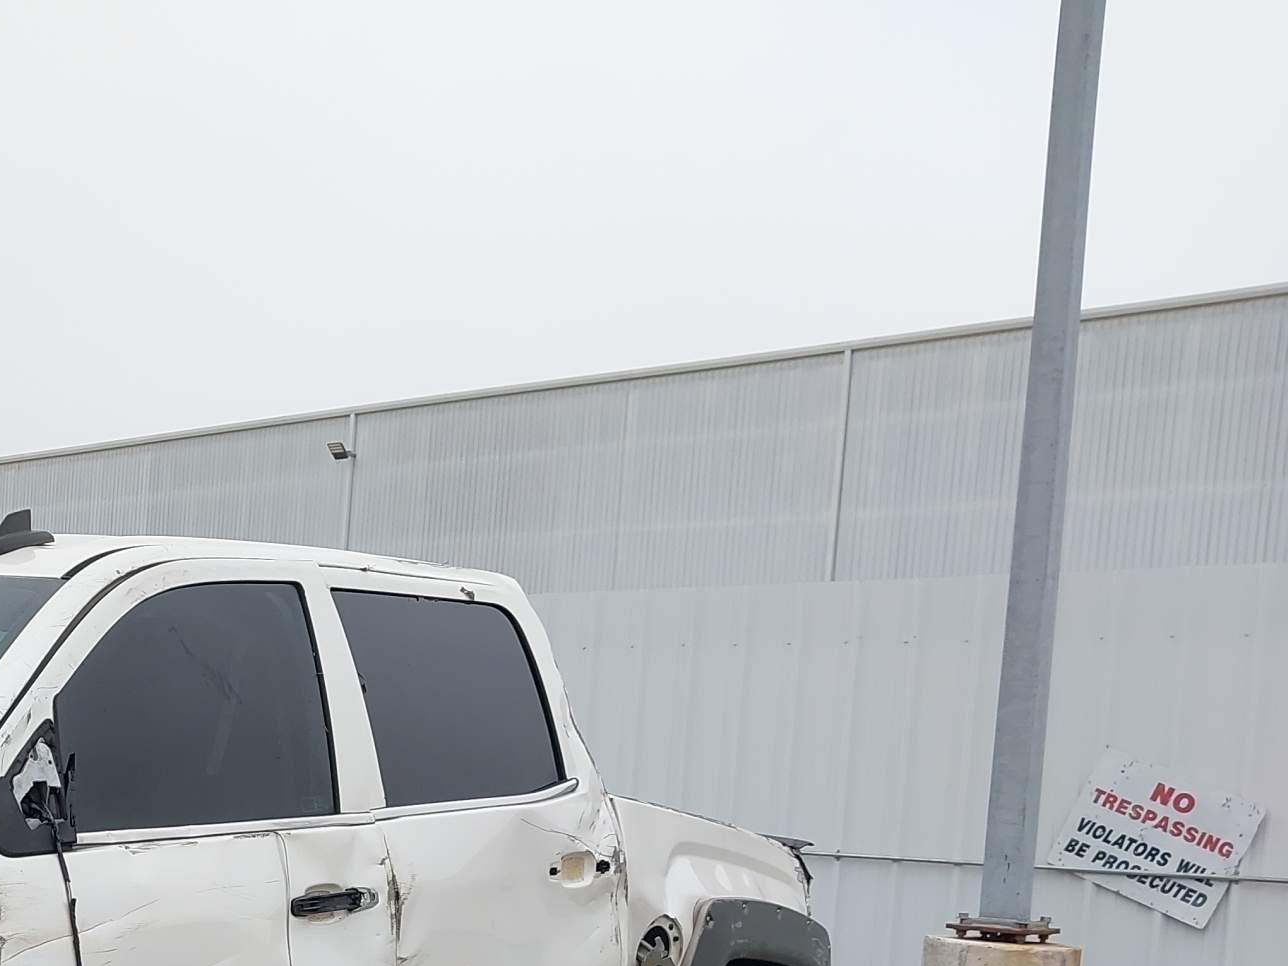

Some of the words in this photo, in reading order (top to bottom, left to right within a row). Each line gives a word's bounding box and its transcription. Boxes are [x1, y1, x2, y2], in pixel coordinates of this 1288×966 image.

[1149, 782, 1196, 814] NO
[1077, 817, 1172, 867] VIOLATORS
[1094, 788, 1234, 859] TRESPASSING
[1064, 838, 1091, 858] BE
